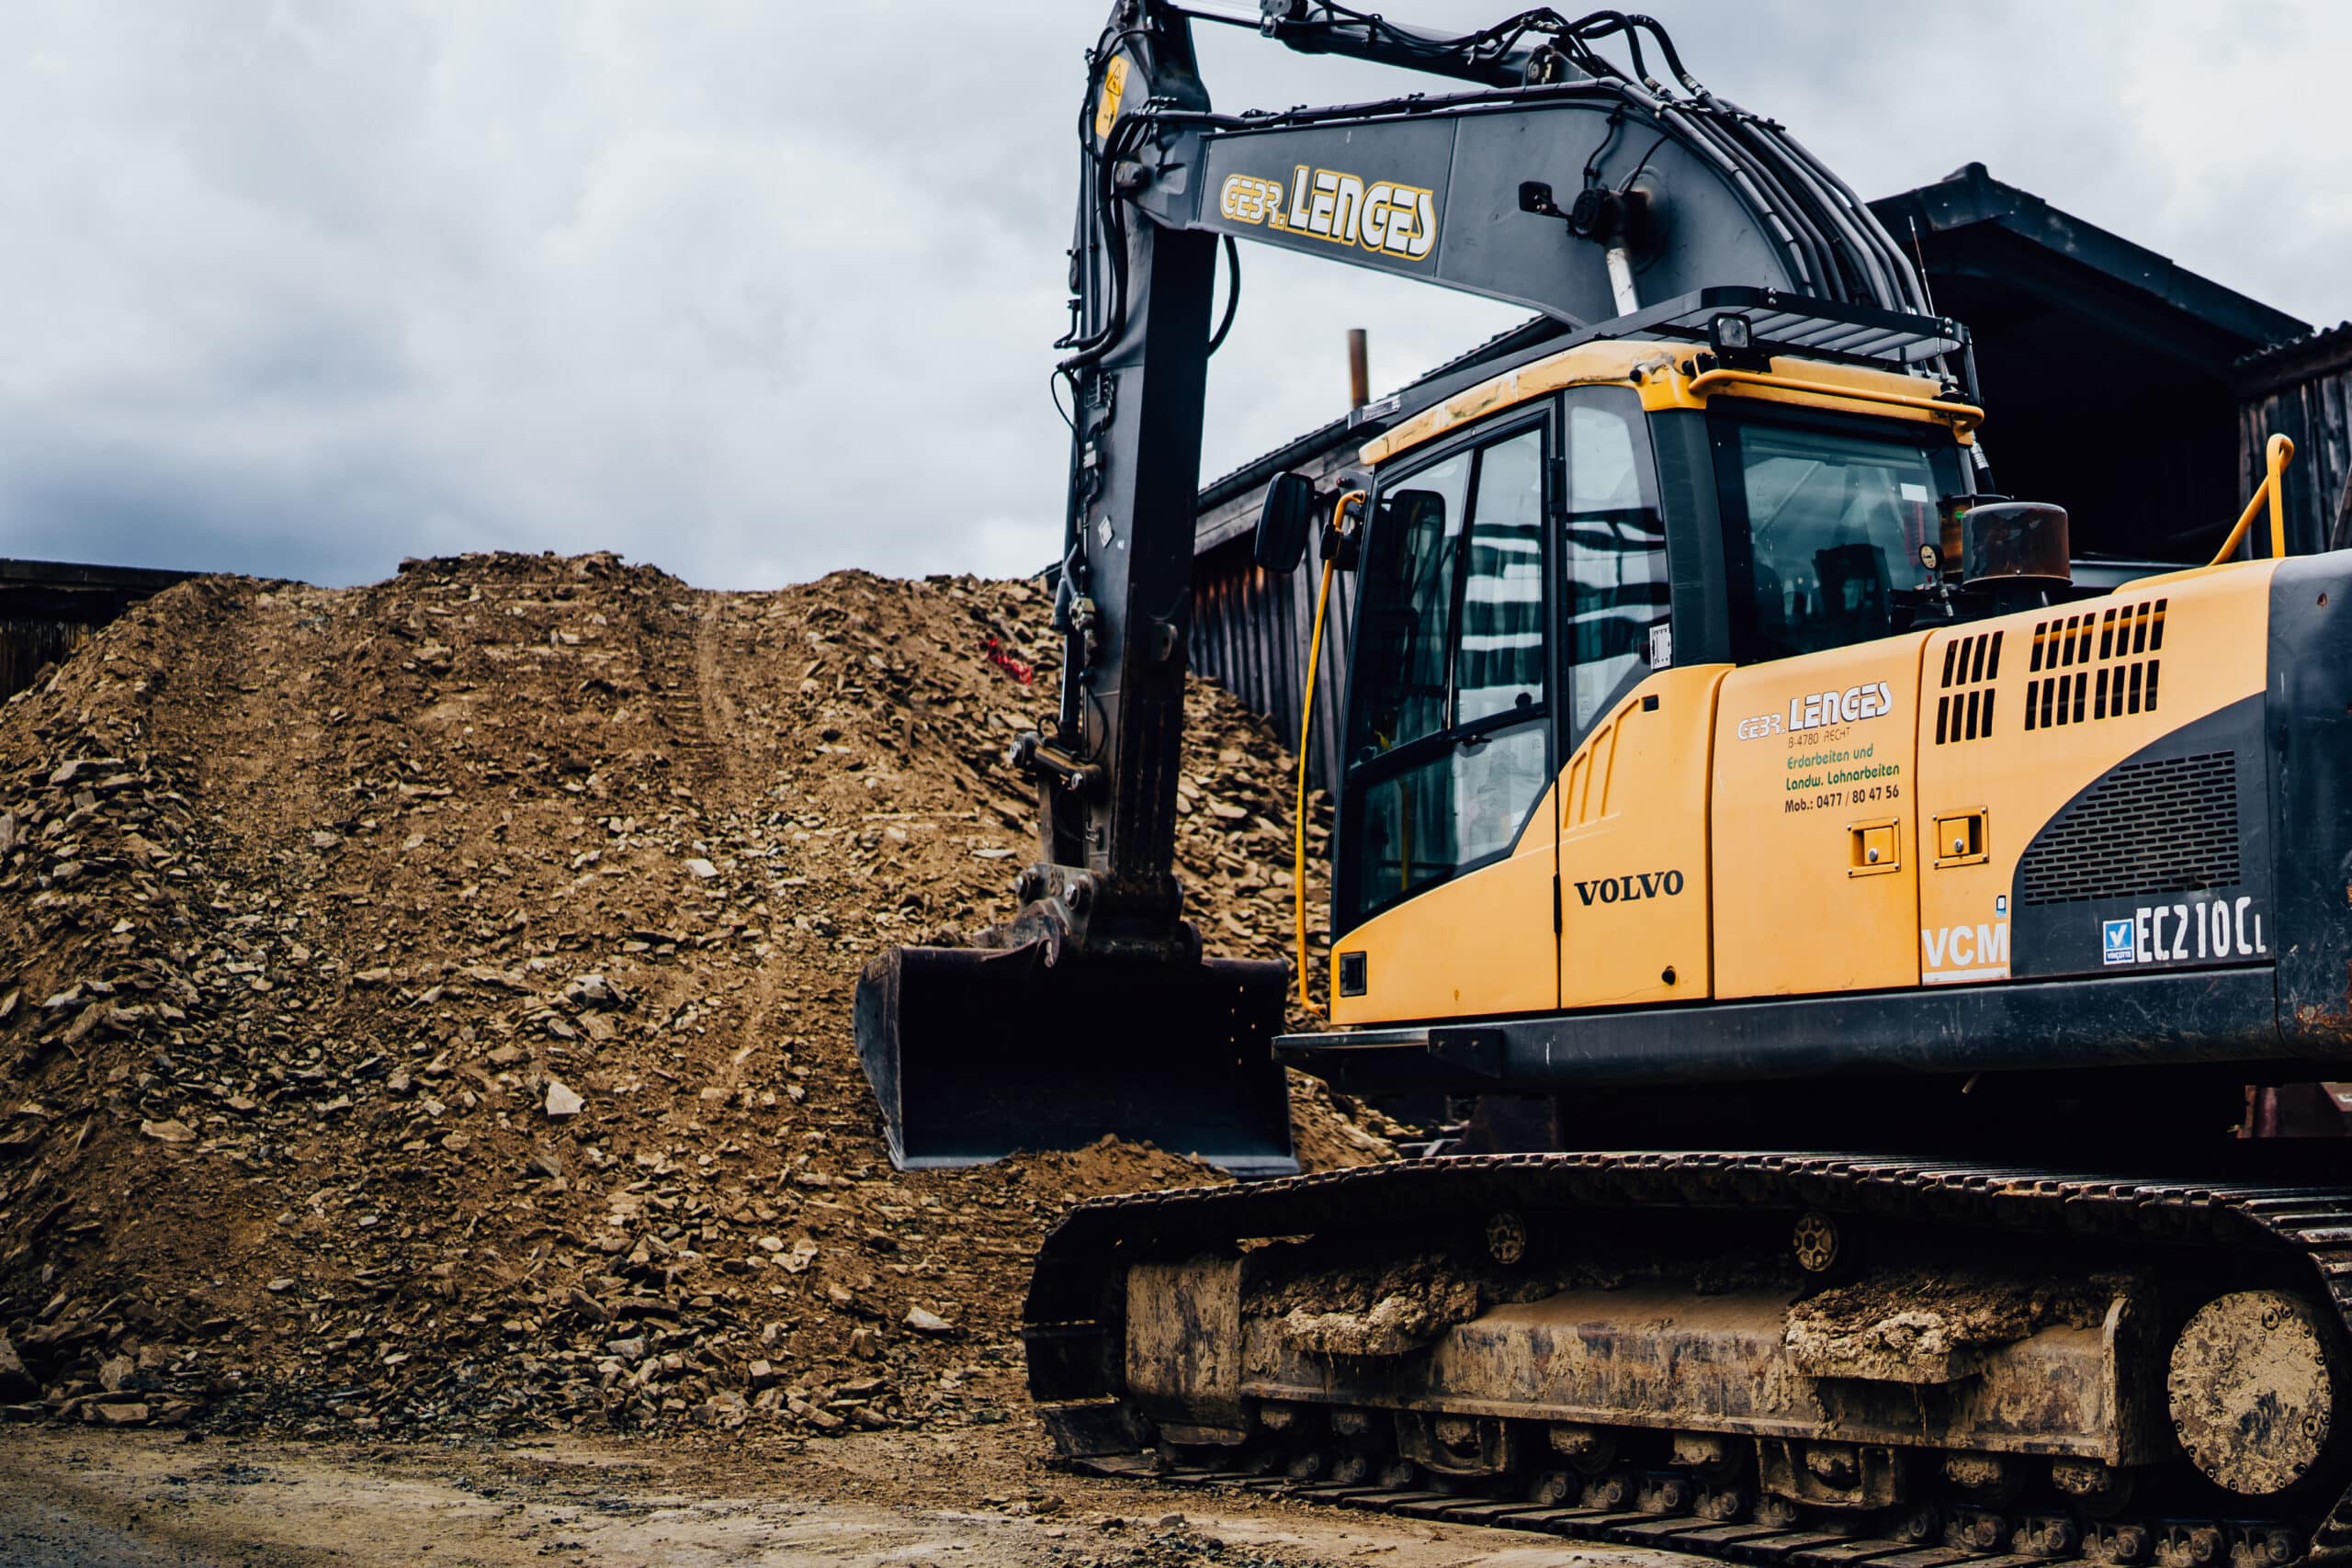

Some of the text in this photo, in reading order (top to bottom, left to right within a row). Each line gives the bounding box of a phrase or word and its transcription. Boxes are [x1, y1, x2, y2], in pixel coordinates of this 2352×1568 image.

[1220, 164, 1437, 262] GEBR. LENGES
[1737, 681, 1893, 740] GEBR. LENGES
[1787, 743, 1874, 770] Erdarbeiten und
[1786, 763, 1900, 792] Landw. Lohnarbeiten
[1784, 797, 1814, 814] Mob.:
[1816, 793, 1842, 809] 0477
[1852, 788, 1866, 804] 80
[1869, 786, 1882, 801] 47
[1886, 784, 1900, 799] 56
[1574, 870, 1684, 906] VOLVO
[1921, 922, 2007, 967] VCM
